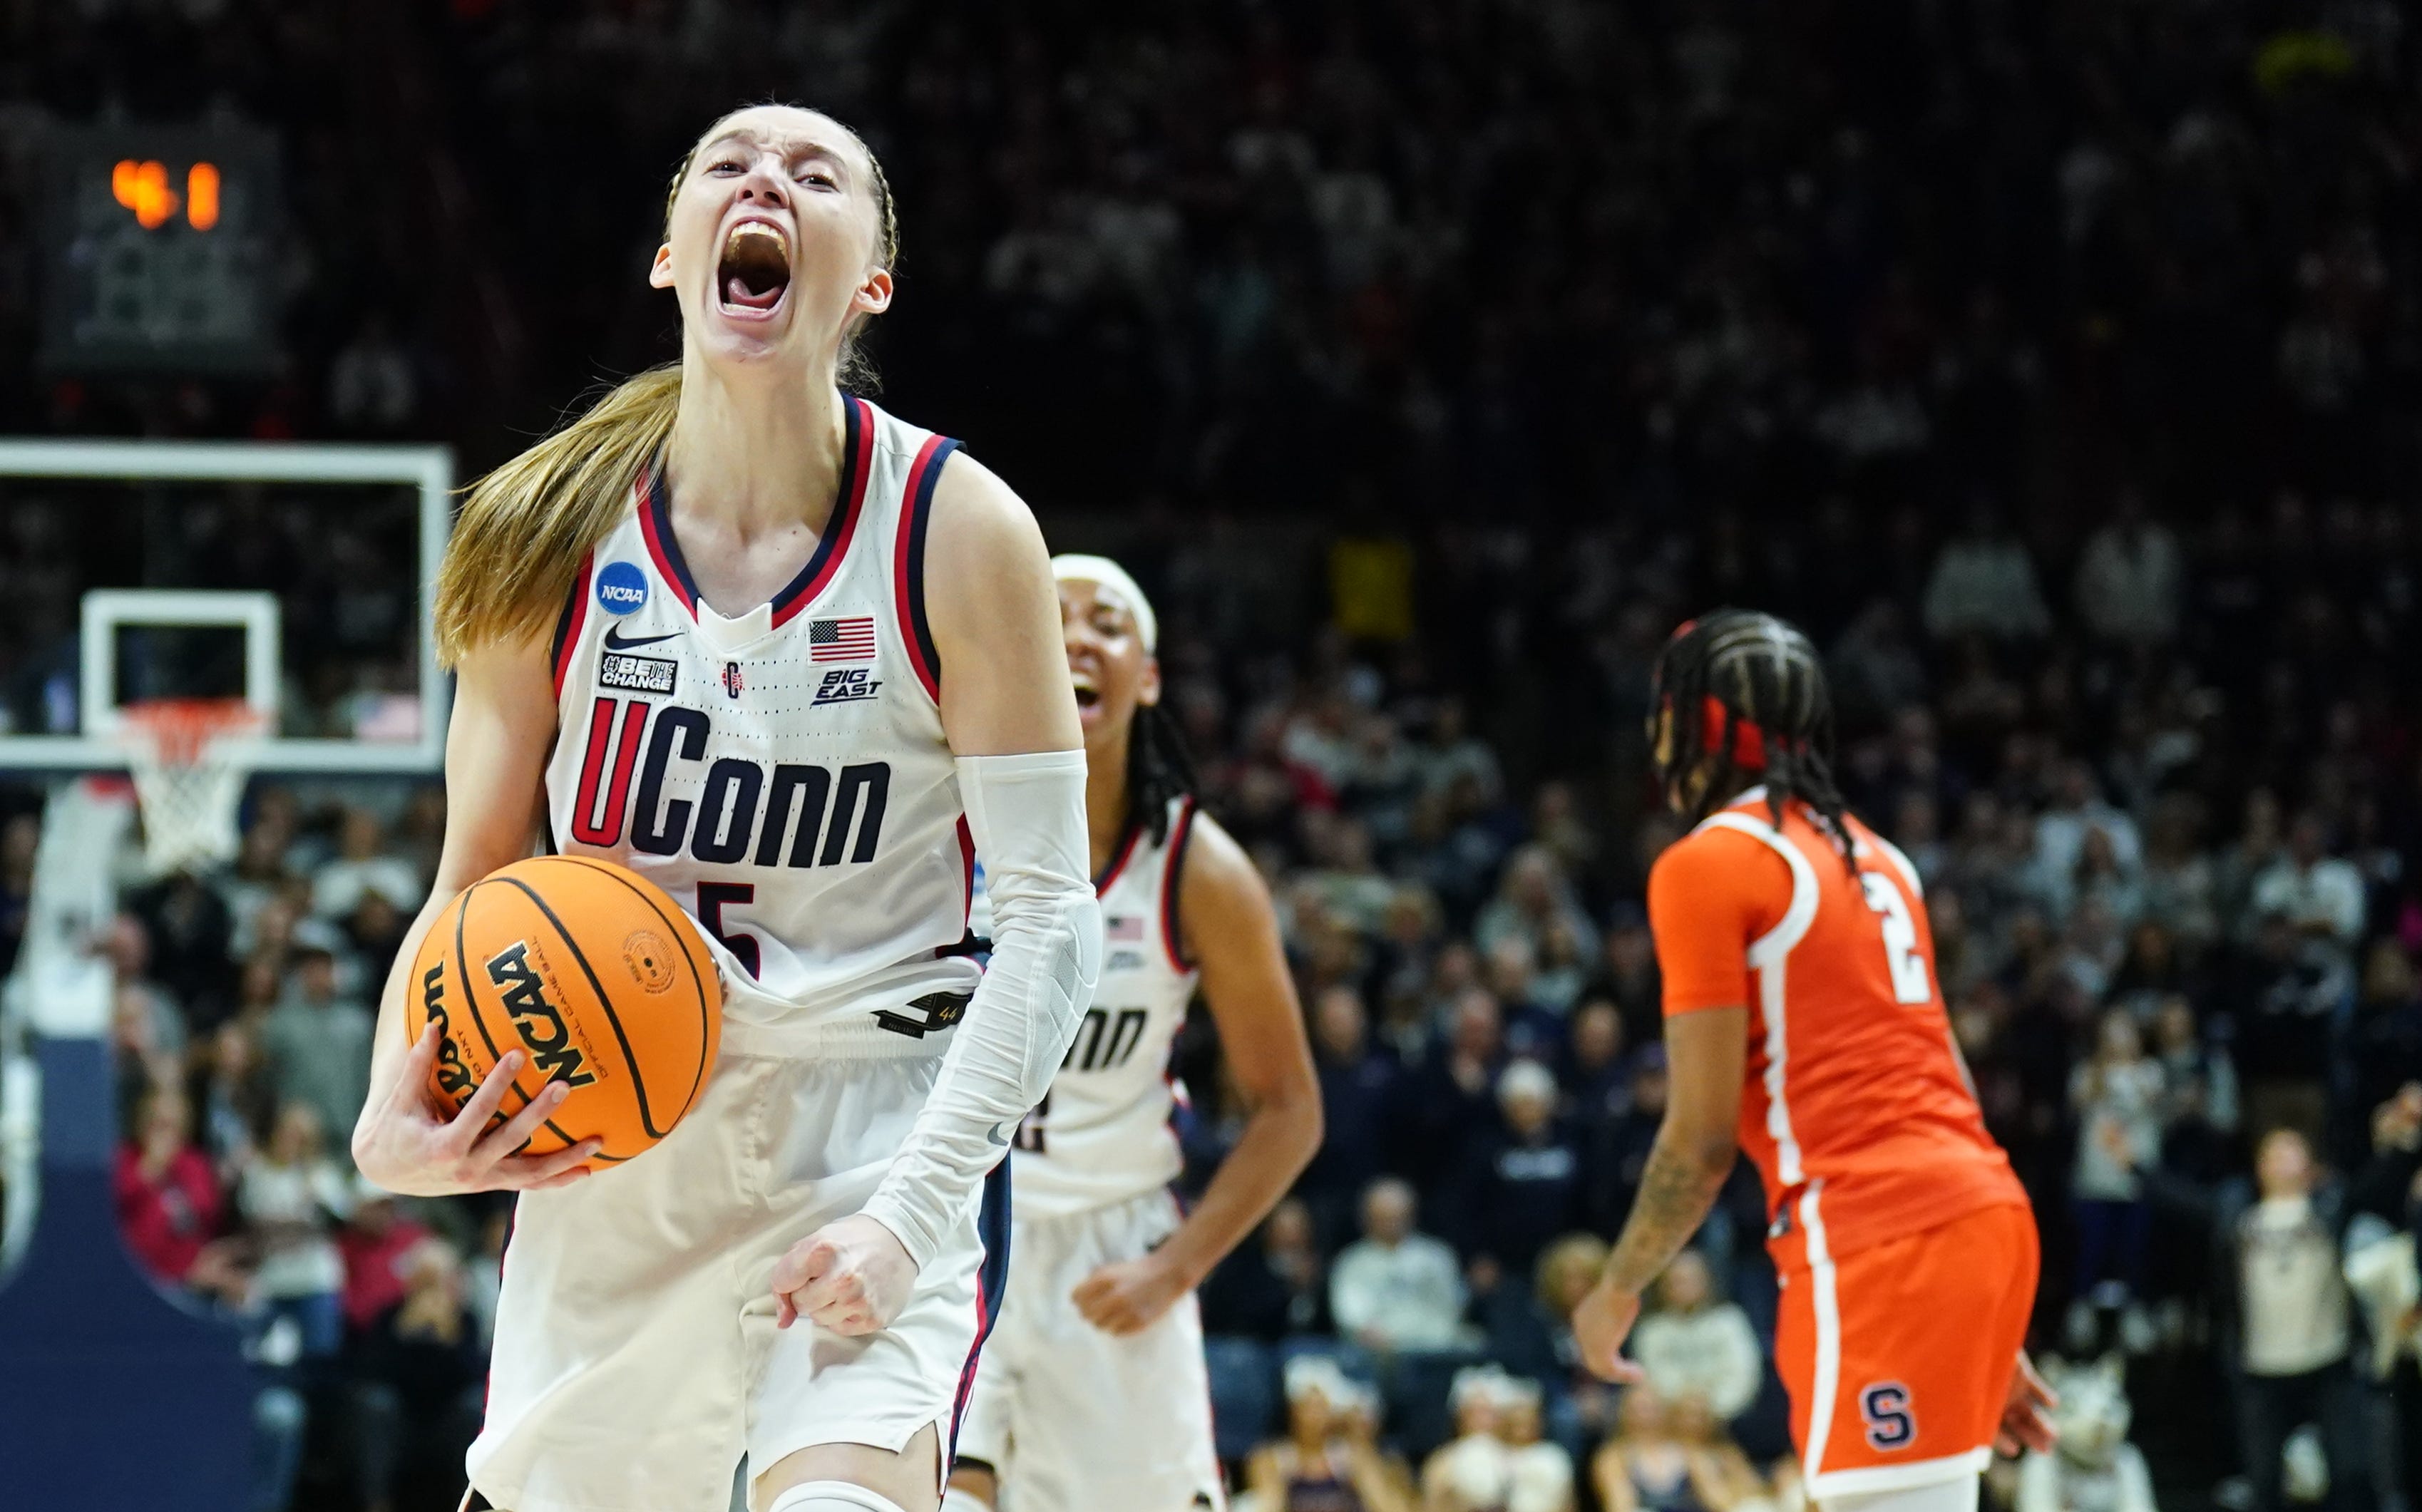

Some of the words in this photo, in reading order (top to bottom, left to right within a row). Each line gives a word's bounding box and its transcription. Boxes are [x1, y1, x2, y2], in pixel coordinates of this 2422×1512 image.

[601, 585, 645, 604] NCAA
[601, 672, 672, 691] CHANGE
[816, 682, 883, 699] EAST
[822, 669, 869, 684] BIG
[697, 881, 761, 982] 5
[1860, 872, 1931, 1004] 2
[533, 935, 550, 974] BALL
[485, 940, 597, 1089] NCAA
[548, 973, 573, 1017] GAME
[938, 1006, 958, 1021] 44
[456, 1029, 473, 1059] NXT
[574, 1018, 608, 1079] OFFICIAL
[1860, 1382, 1916, 1448] S
